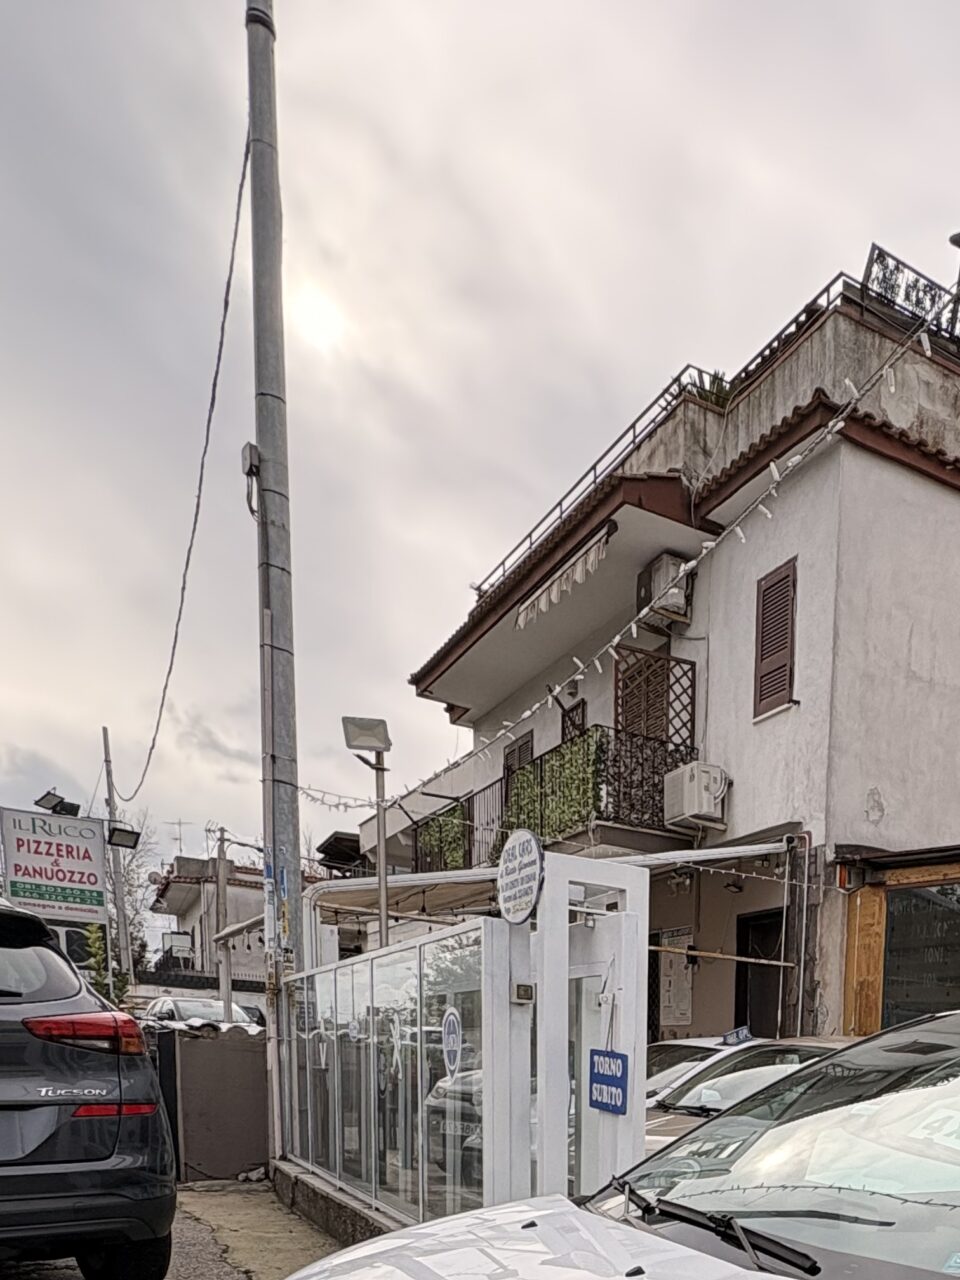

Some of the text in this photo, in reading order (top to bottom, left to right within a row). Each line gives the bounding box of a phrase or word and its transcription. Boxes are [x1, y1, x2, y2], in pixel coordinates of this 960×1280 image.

[16, 837, 93, 862] PIZZERIA
[13, 863, 98, 886] PANUOZZO
[50, 858, 61, 868] &
[593, 1054, 623, 1078] TORNO
[591, 1082, 623, 1108] SUBITO
